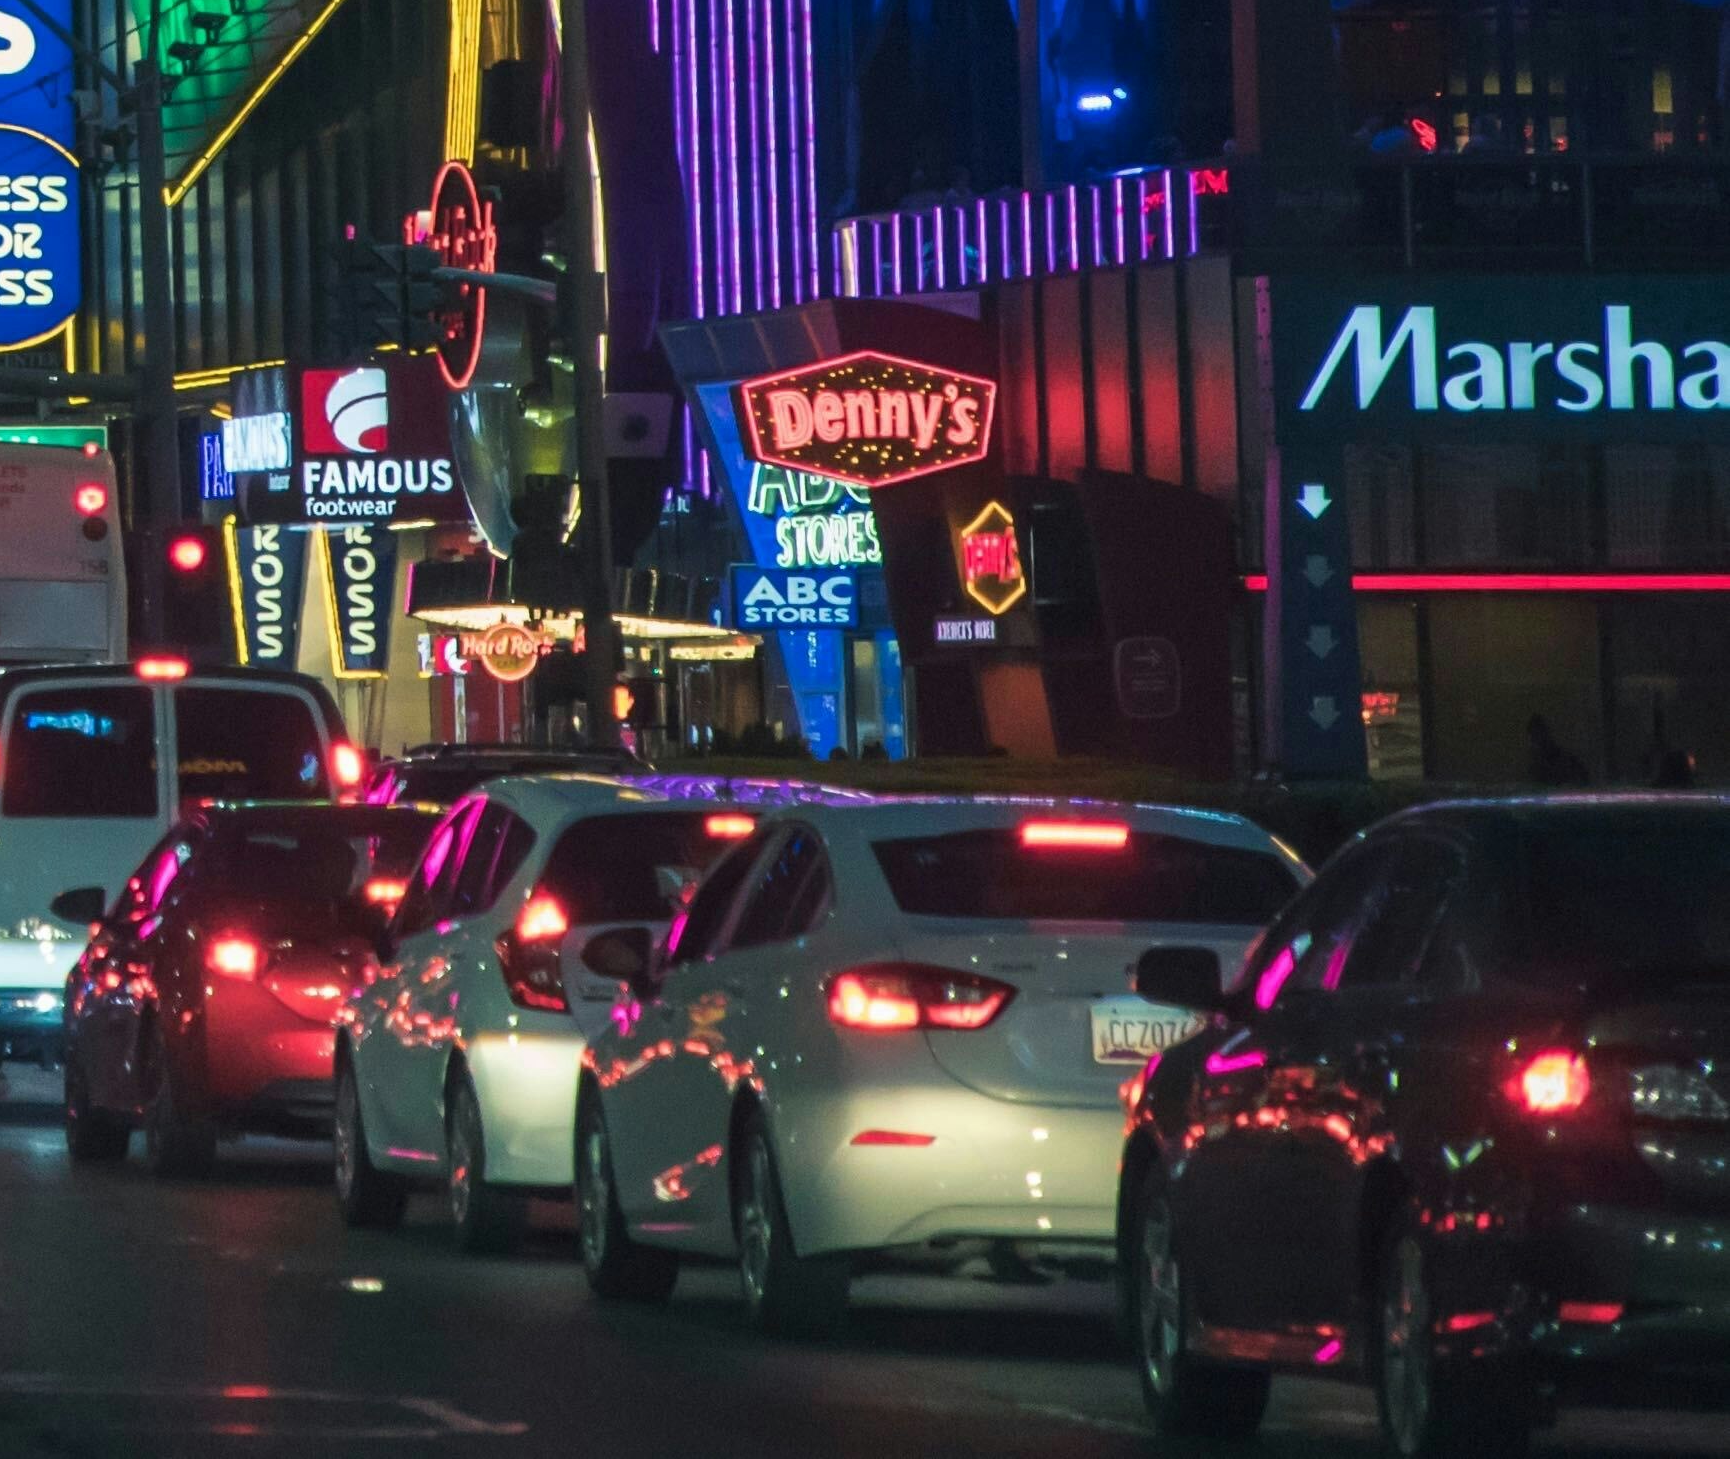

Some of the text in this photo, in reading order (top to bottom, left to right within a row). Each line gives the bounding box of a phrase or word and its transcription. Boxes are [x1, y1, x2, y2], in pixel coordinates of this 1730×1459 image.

[1299, 305, 1730, 411] Marsha
[765, 383, 979, 450] Denny's
[303, 459, 454, 496] FAMOUS
[305, 496, 398, 517] footwear
[775, 511, 883, 568] STORES
[253, 523, 285, 660] ROSS
[343, 524, 377, 656] ROSS
[743, 575, 853, 606] ABC
[745, 607, 850, 623] STORES
